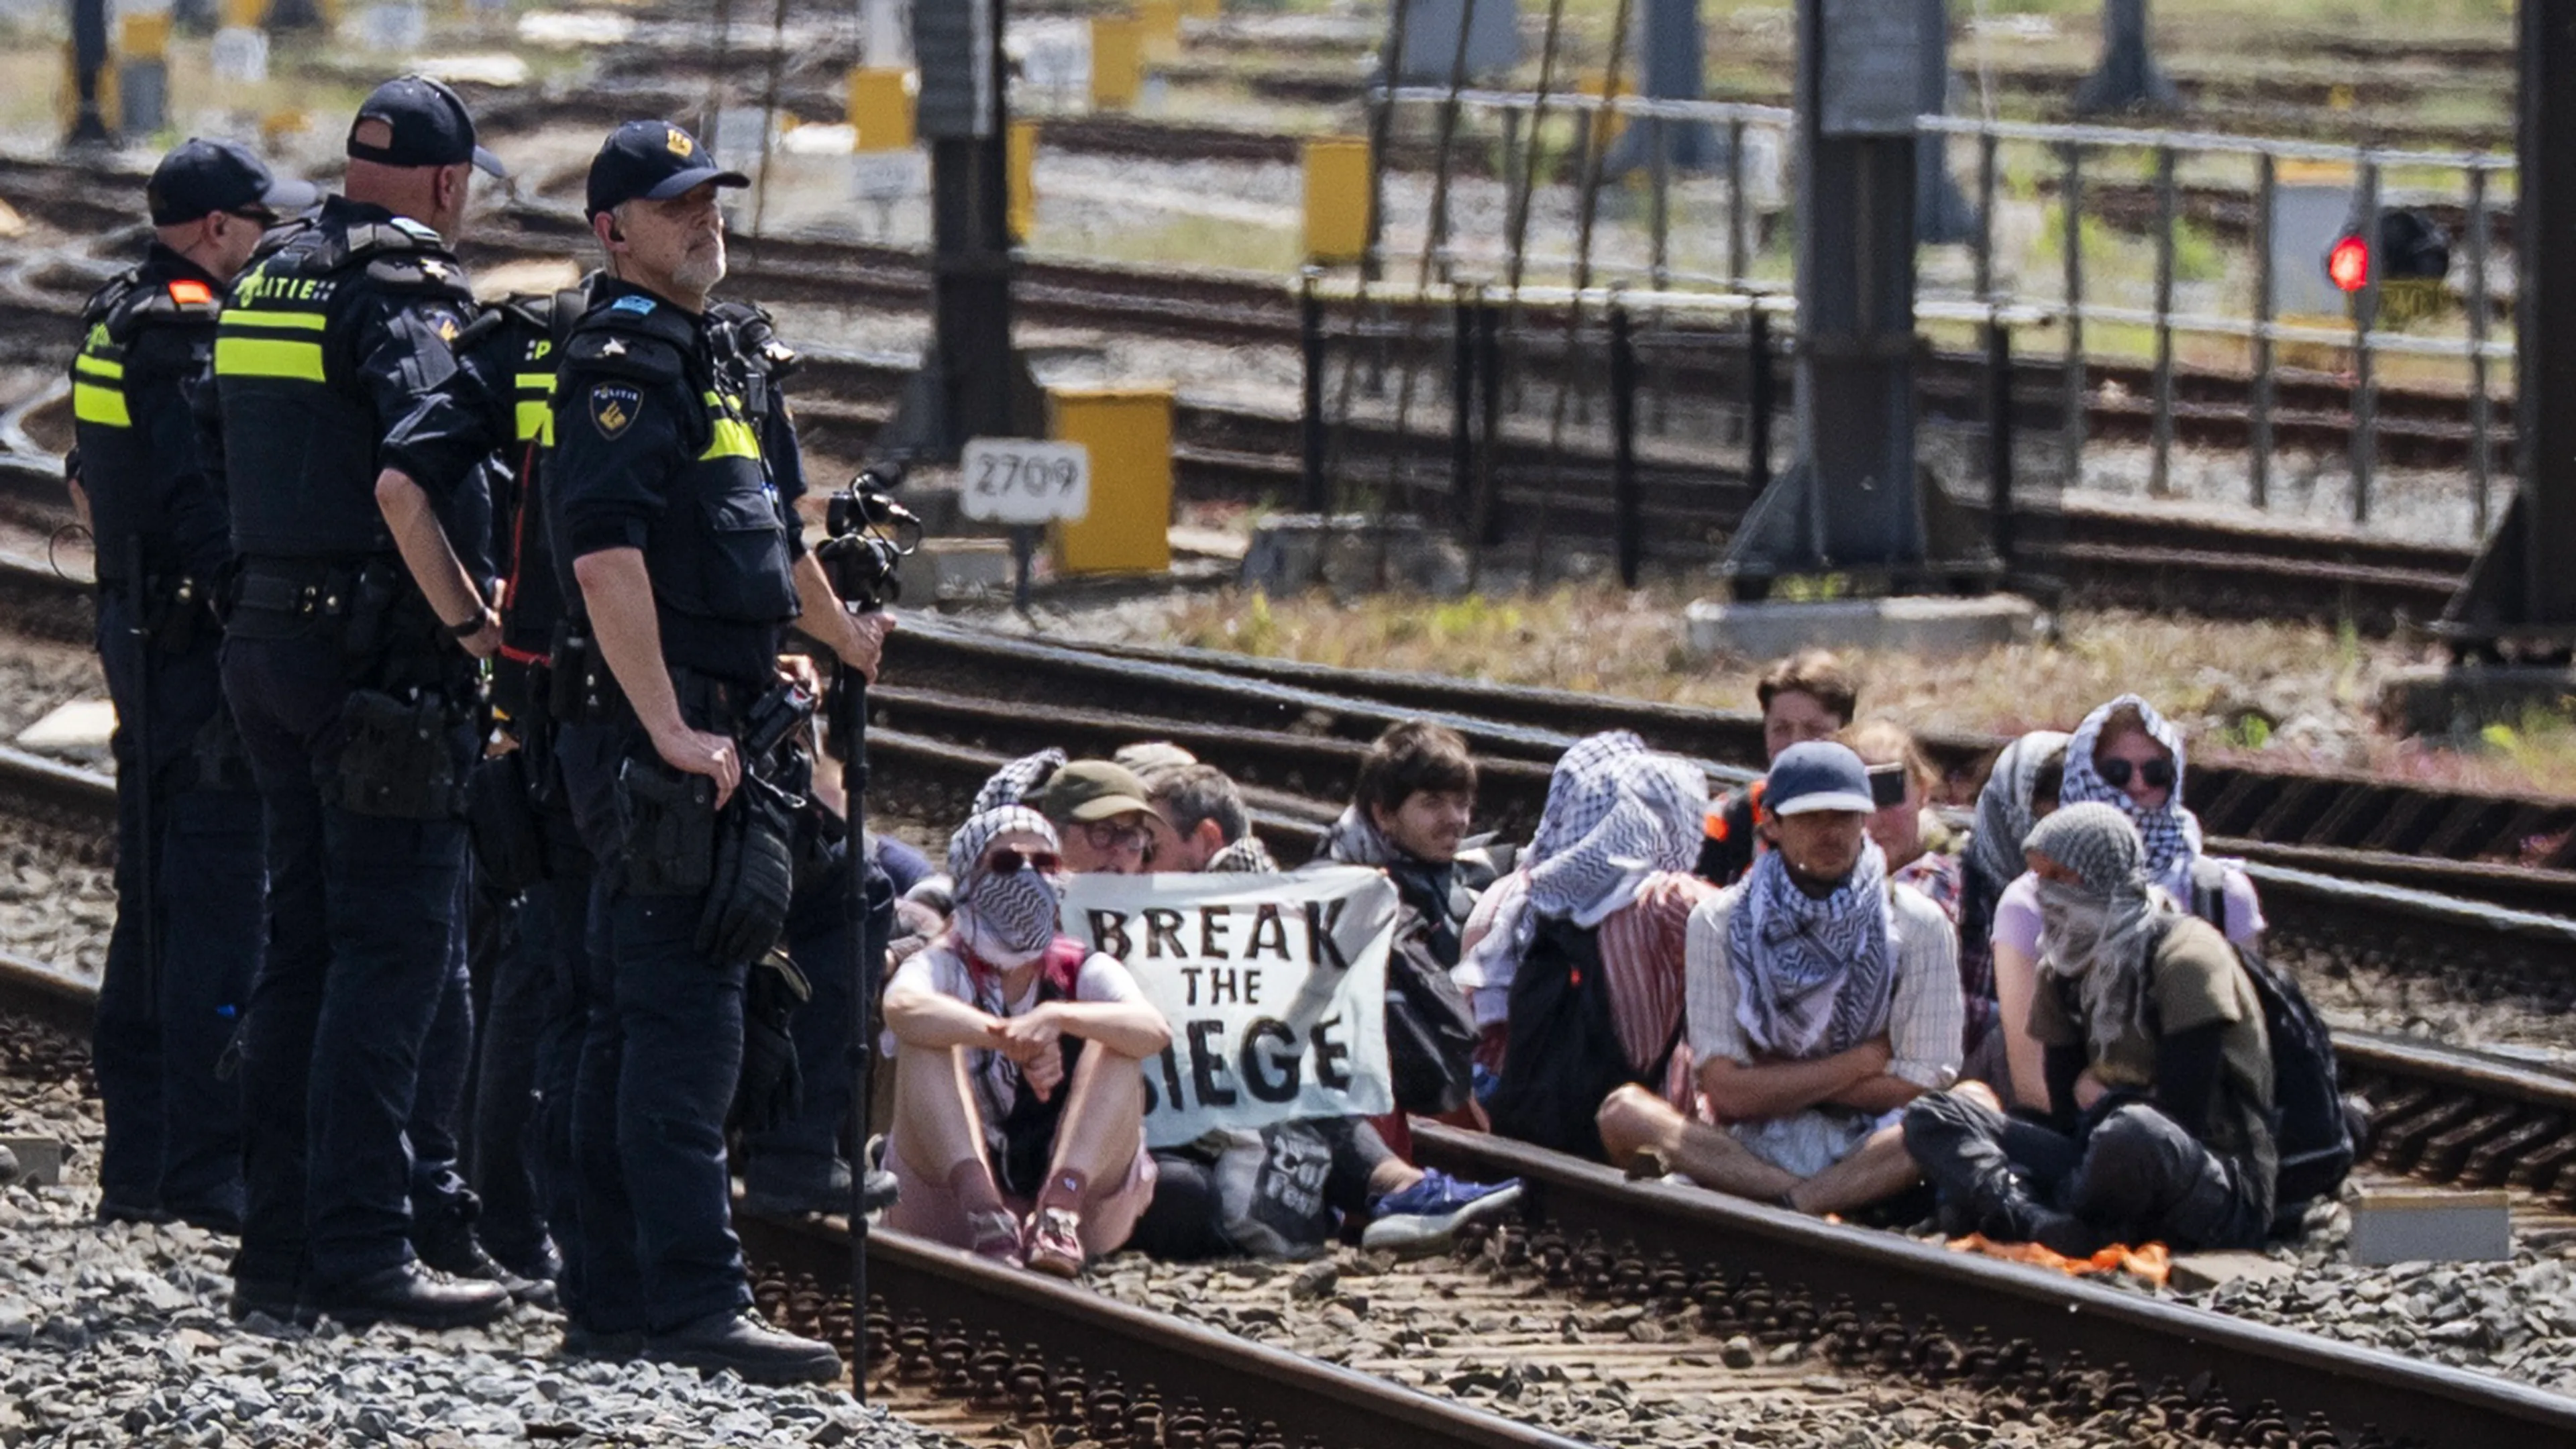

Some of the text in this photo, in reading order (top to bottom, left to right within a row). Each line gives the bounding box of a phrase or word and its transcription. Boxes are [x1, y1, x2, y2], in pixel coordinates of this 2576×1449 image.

[975, 452, 1079, 498] 2709
[1087, 898, 1348, 969] BREAK
[1181, 967, 1262, 1006] THE
